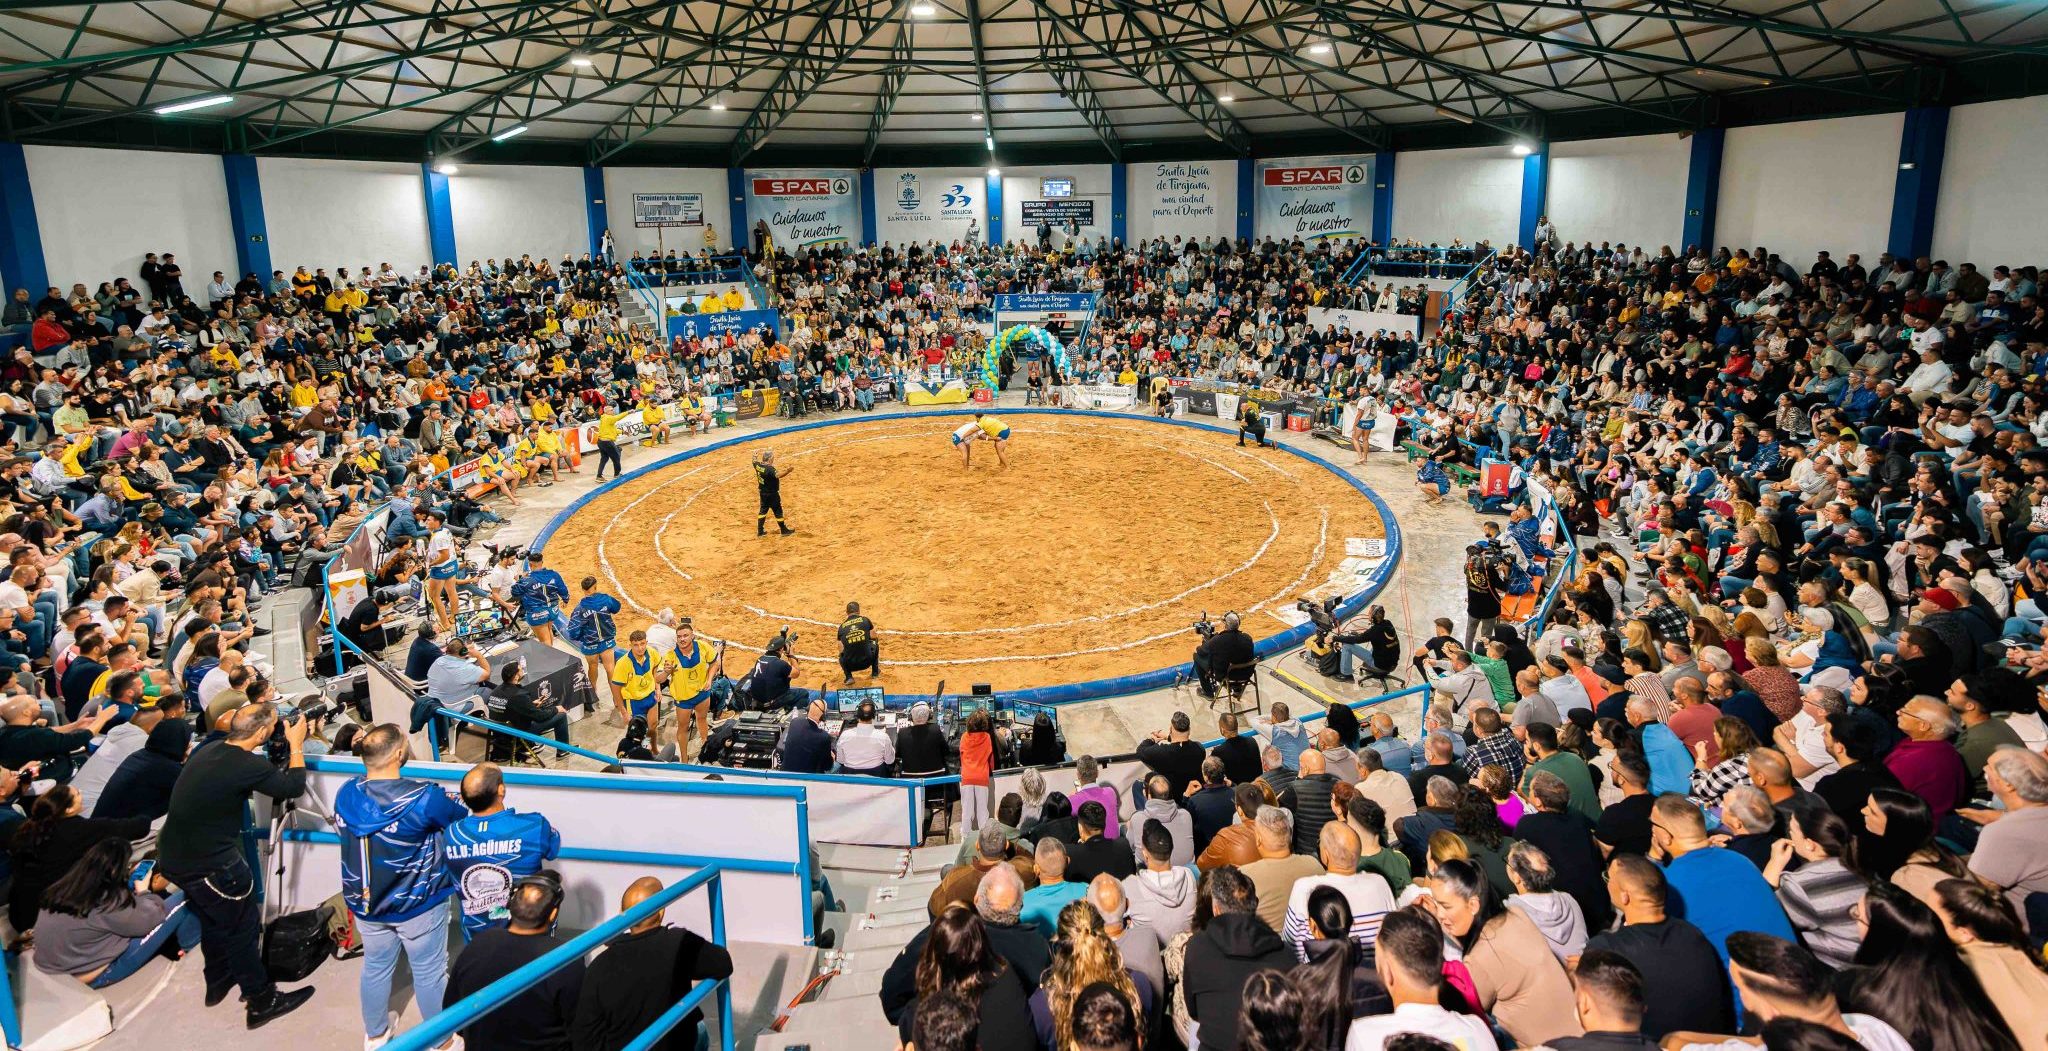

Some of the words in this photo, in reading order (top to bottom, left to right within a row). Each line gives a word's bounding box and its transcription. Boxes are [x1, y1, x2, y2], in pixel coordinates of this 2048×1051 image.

[1157, 164, 1185, 176] Santa
[1282, 170, 1341, 182] SPAR
[772, 182, 829, 192] SPAR
[1156, 180, 1166, 190] de
[1179, 194, 1204, 204] ciudad
[1152, 209, 1171, 218] para
[1181, 204, 1214, 217] Deporte
[1280, 198, 1335, 217] Cuidamos
[773, 208, 826, 225] Cuidamos
[1296, 217, 1306, 232] lo
[1309, 215, 1352, 231] nuestro
[790, 225, 800, 239] lo
[803, 223, 842, 238] nuestro
[710, 315, 727, 324] Santa
[459, 462, 480, 474] SPA
[446, 844, 471, 860] C.L.U.
[472, 838, 522, 857] AGÜIMES
